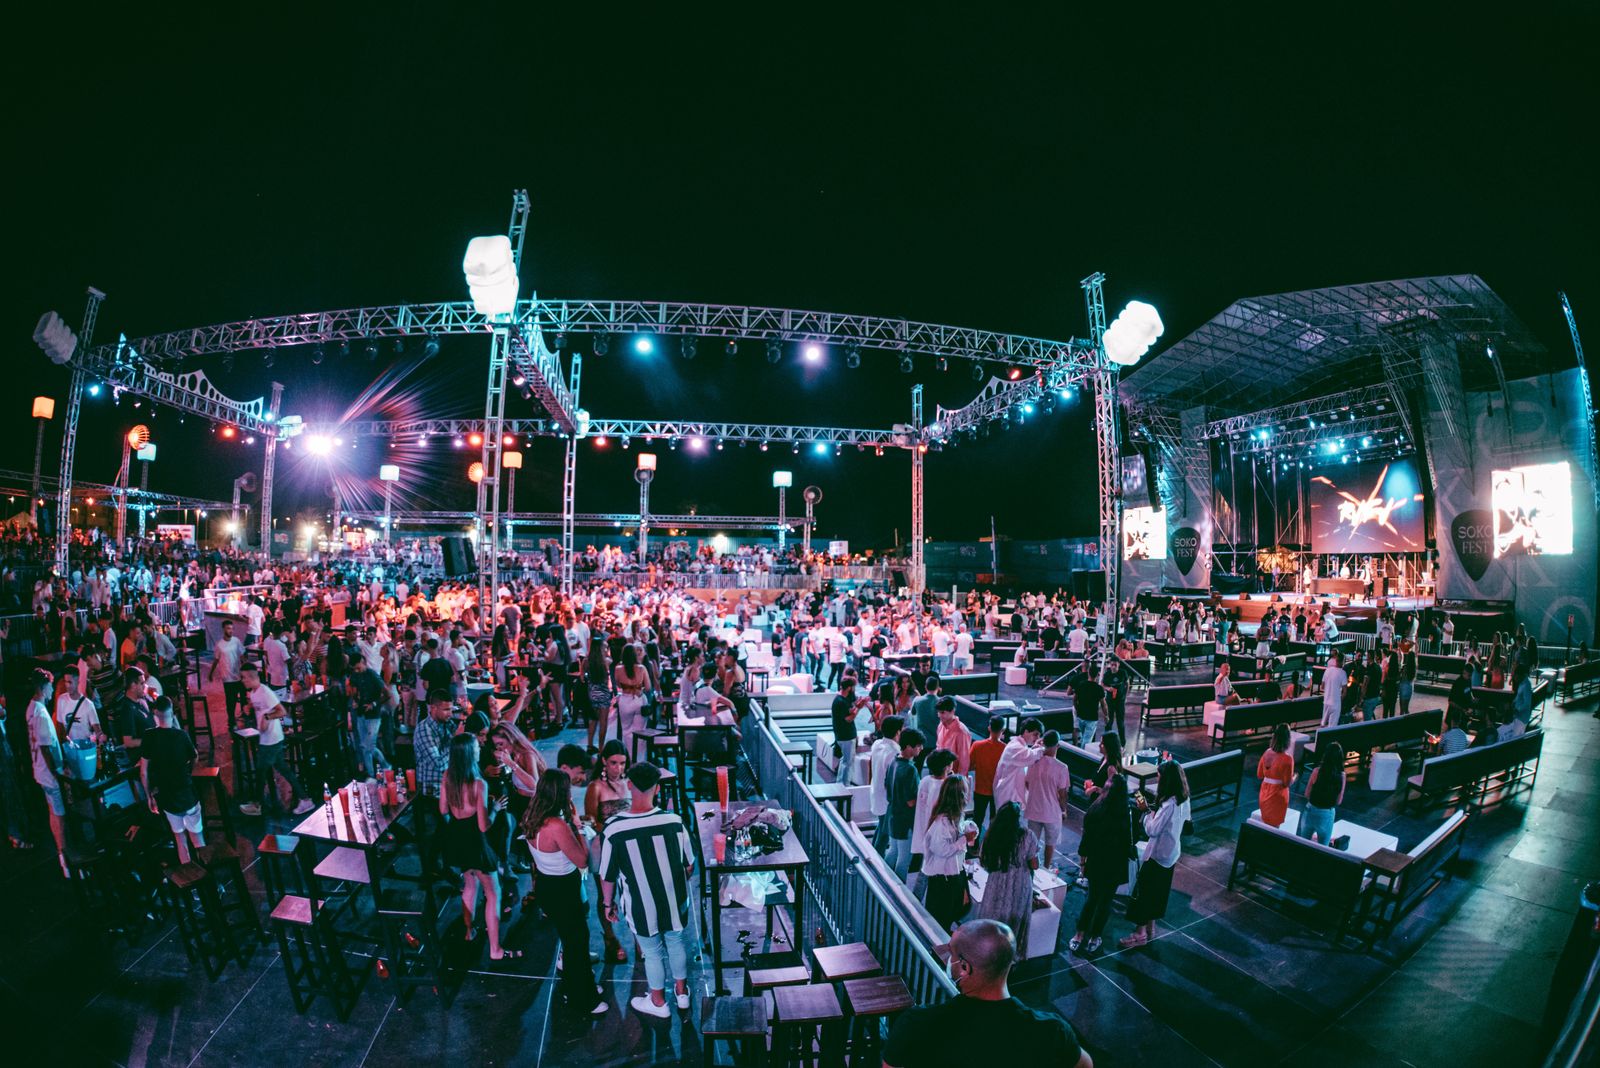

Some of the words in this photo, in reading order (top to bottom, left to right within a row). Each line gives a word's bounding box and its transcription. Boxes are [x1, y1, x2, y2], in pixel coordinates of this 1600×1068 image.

[1174, 537, 1197, 548] SOKO
[1462, 541, 1489, 554] FEST
[1176, 548, 1195, 558] FEST
